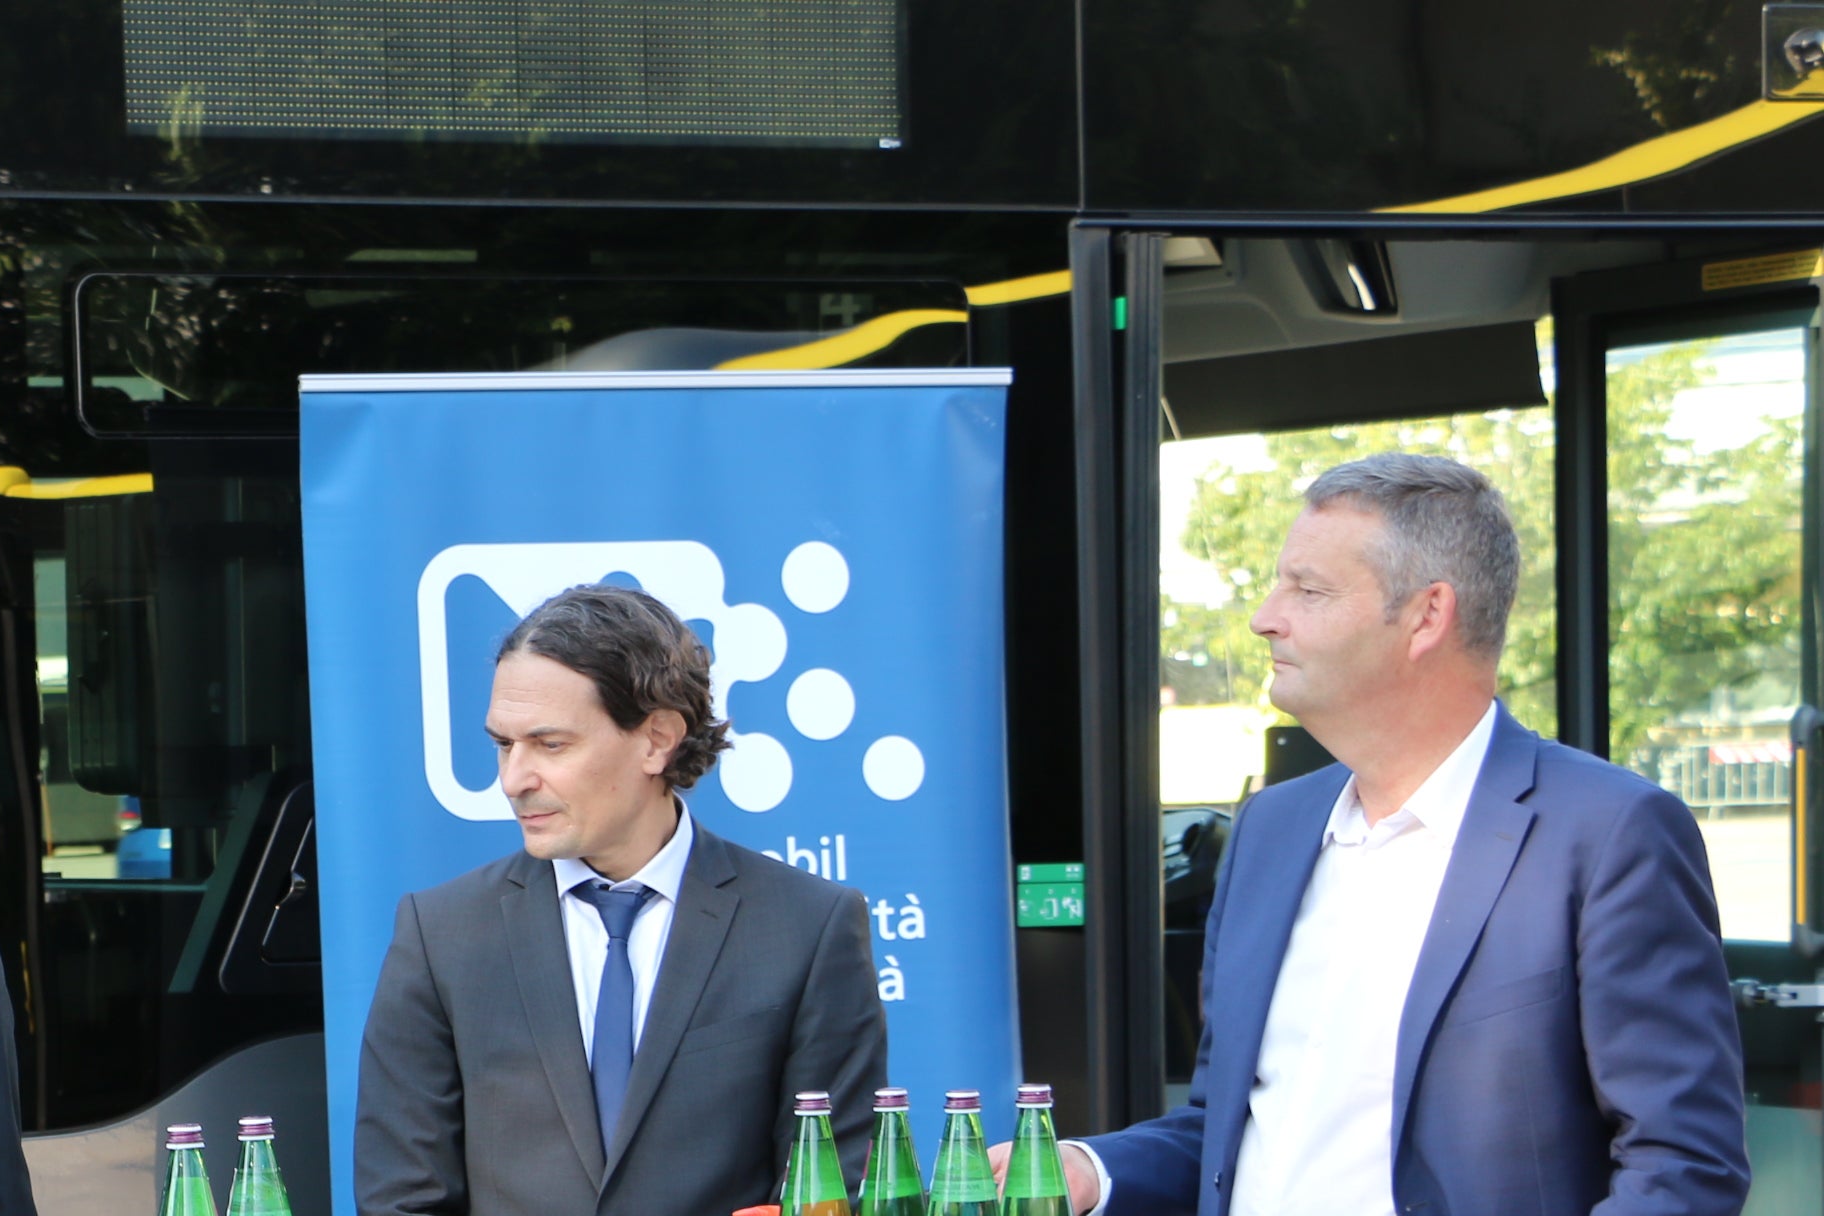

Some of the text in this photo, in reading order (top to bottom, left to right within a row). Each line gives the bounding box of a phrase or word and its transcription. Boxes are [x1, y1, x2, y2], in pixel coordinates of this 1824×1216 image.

[761, 834, 846, 881] bil
[864, 893, 926, 941] tà
[878, 955, 905, 1002] à
